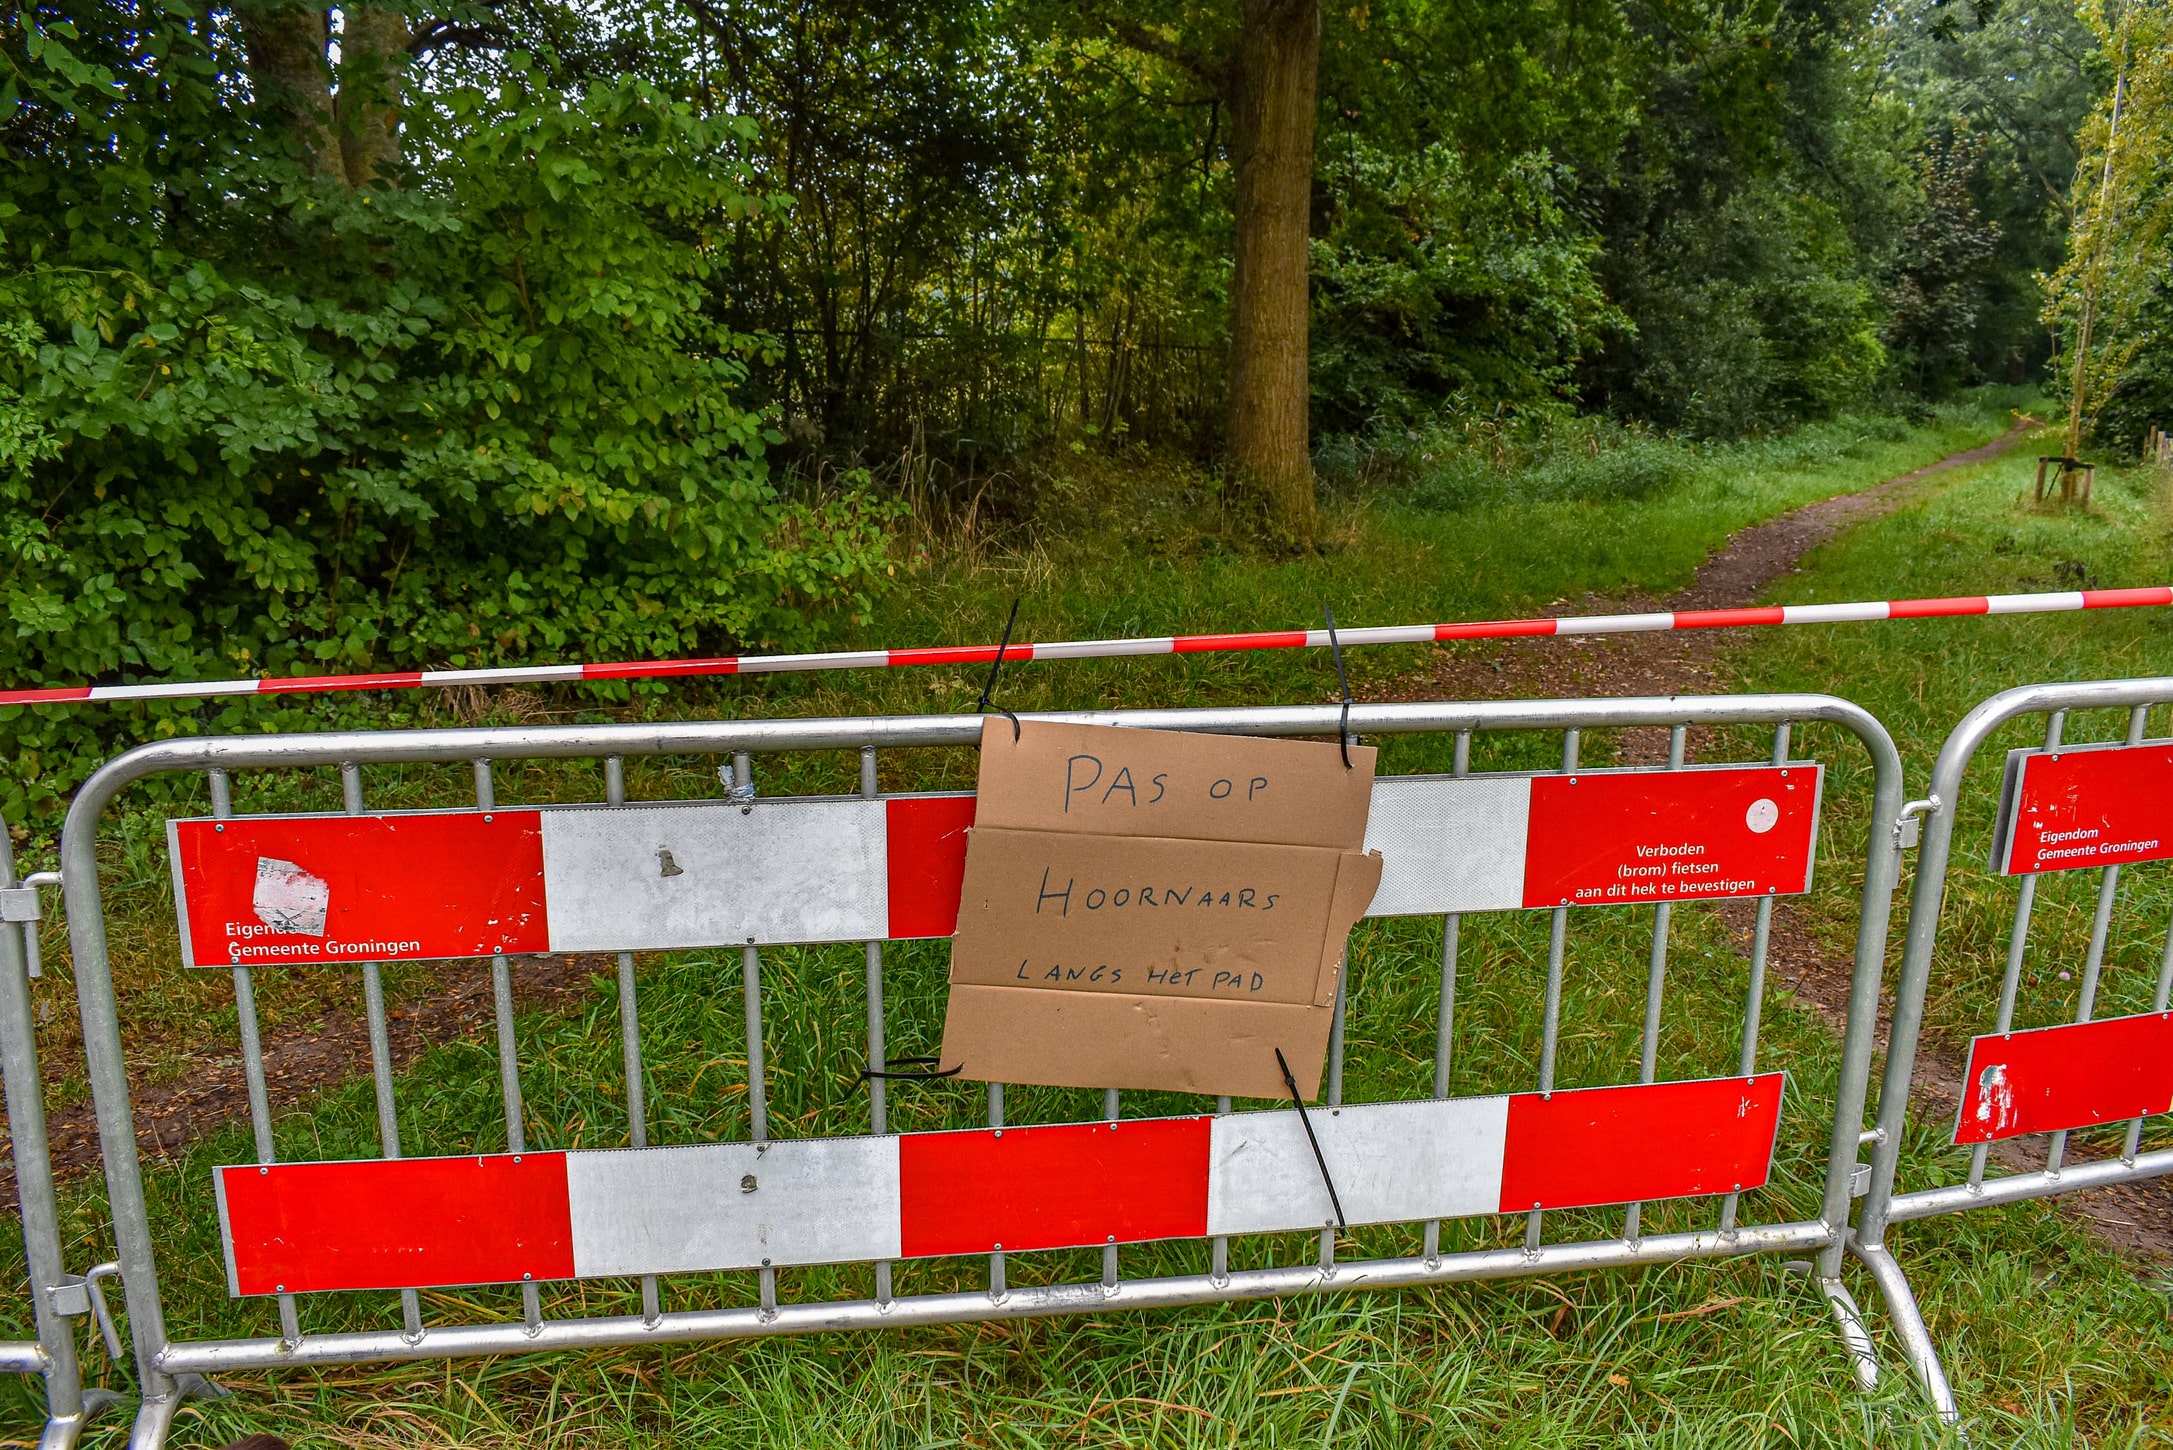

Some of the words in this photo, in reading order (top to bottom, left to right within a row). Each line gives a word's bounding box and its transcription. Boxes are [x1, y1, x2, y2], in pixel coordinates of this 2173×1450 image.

[1064, 754, 1169, 813] PAS
[1209, 776, 1268, 802] OP
[2040, 828, 2099, 844] Eigendom
[1636, 842, 1705, 858] Verboden
[2037, 845, 2097, 860] Gemeente
[2099, 839, 2159, 855] Groningen
[1617, 863, 1667, 879] (brom)
[1671, 862, 1719, 875] fietsen
[1036, 866, 1280, 918] HOORNAARS
[1575, 887, 1602, 898] aan
[1606, 883, 1627, 897] dit
[1631, 881, 1657, 895] hek
[1661, 883, 1676, 894] te
[1679, 878, 1756, 894] bevestigen
[228, 941, 320, 957] Gemeente
[325, 938, 421, 956] Groningen
[1017, 959, 1122, 985] LANGS
[1212, 969, 1264, 992] PAD
